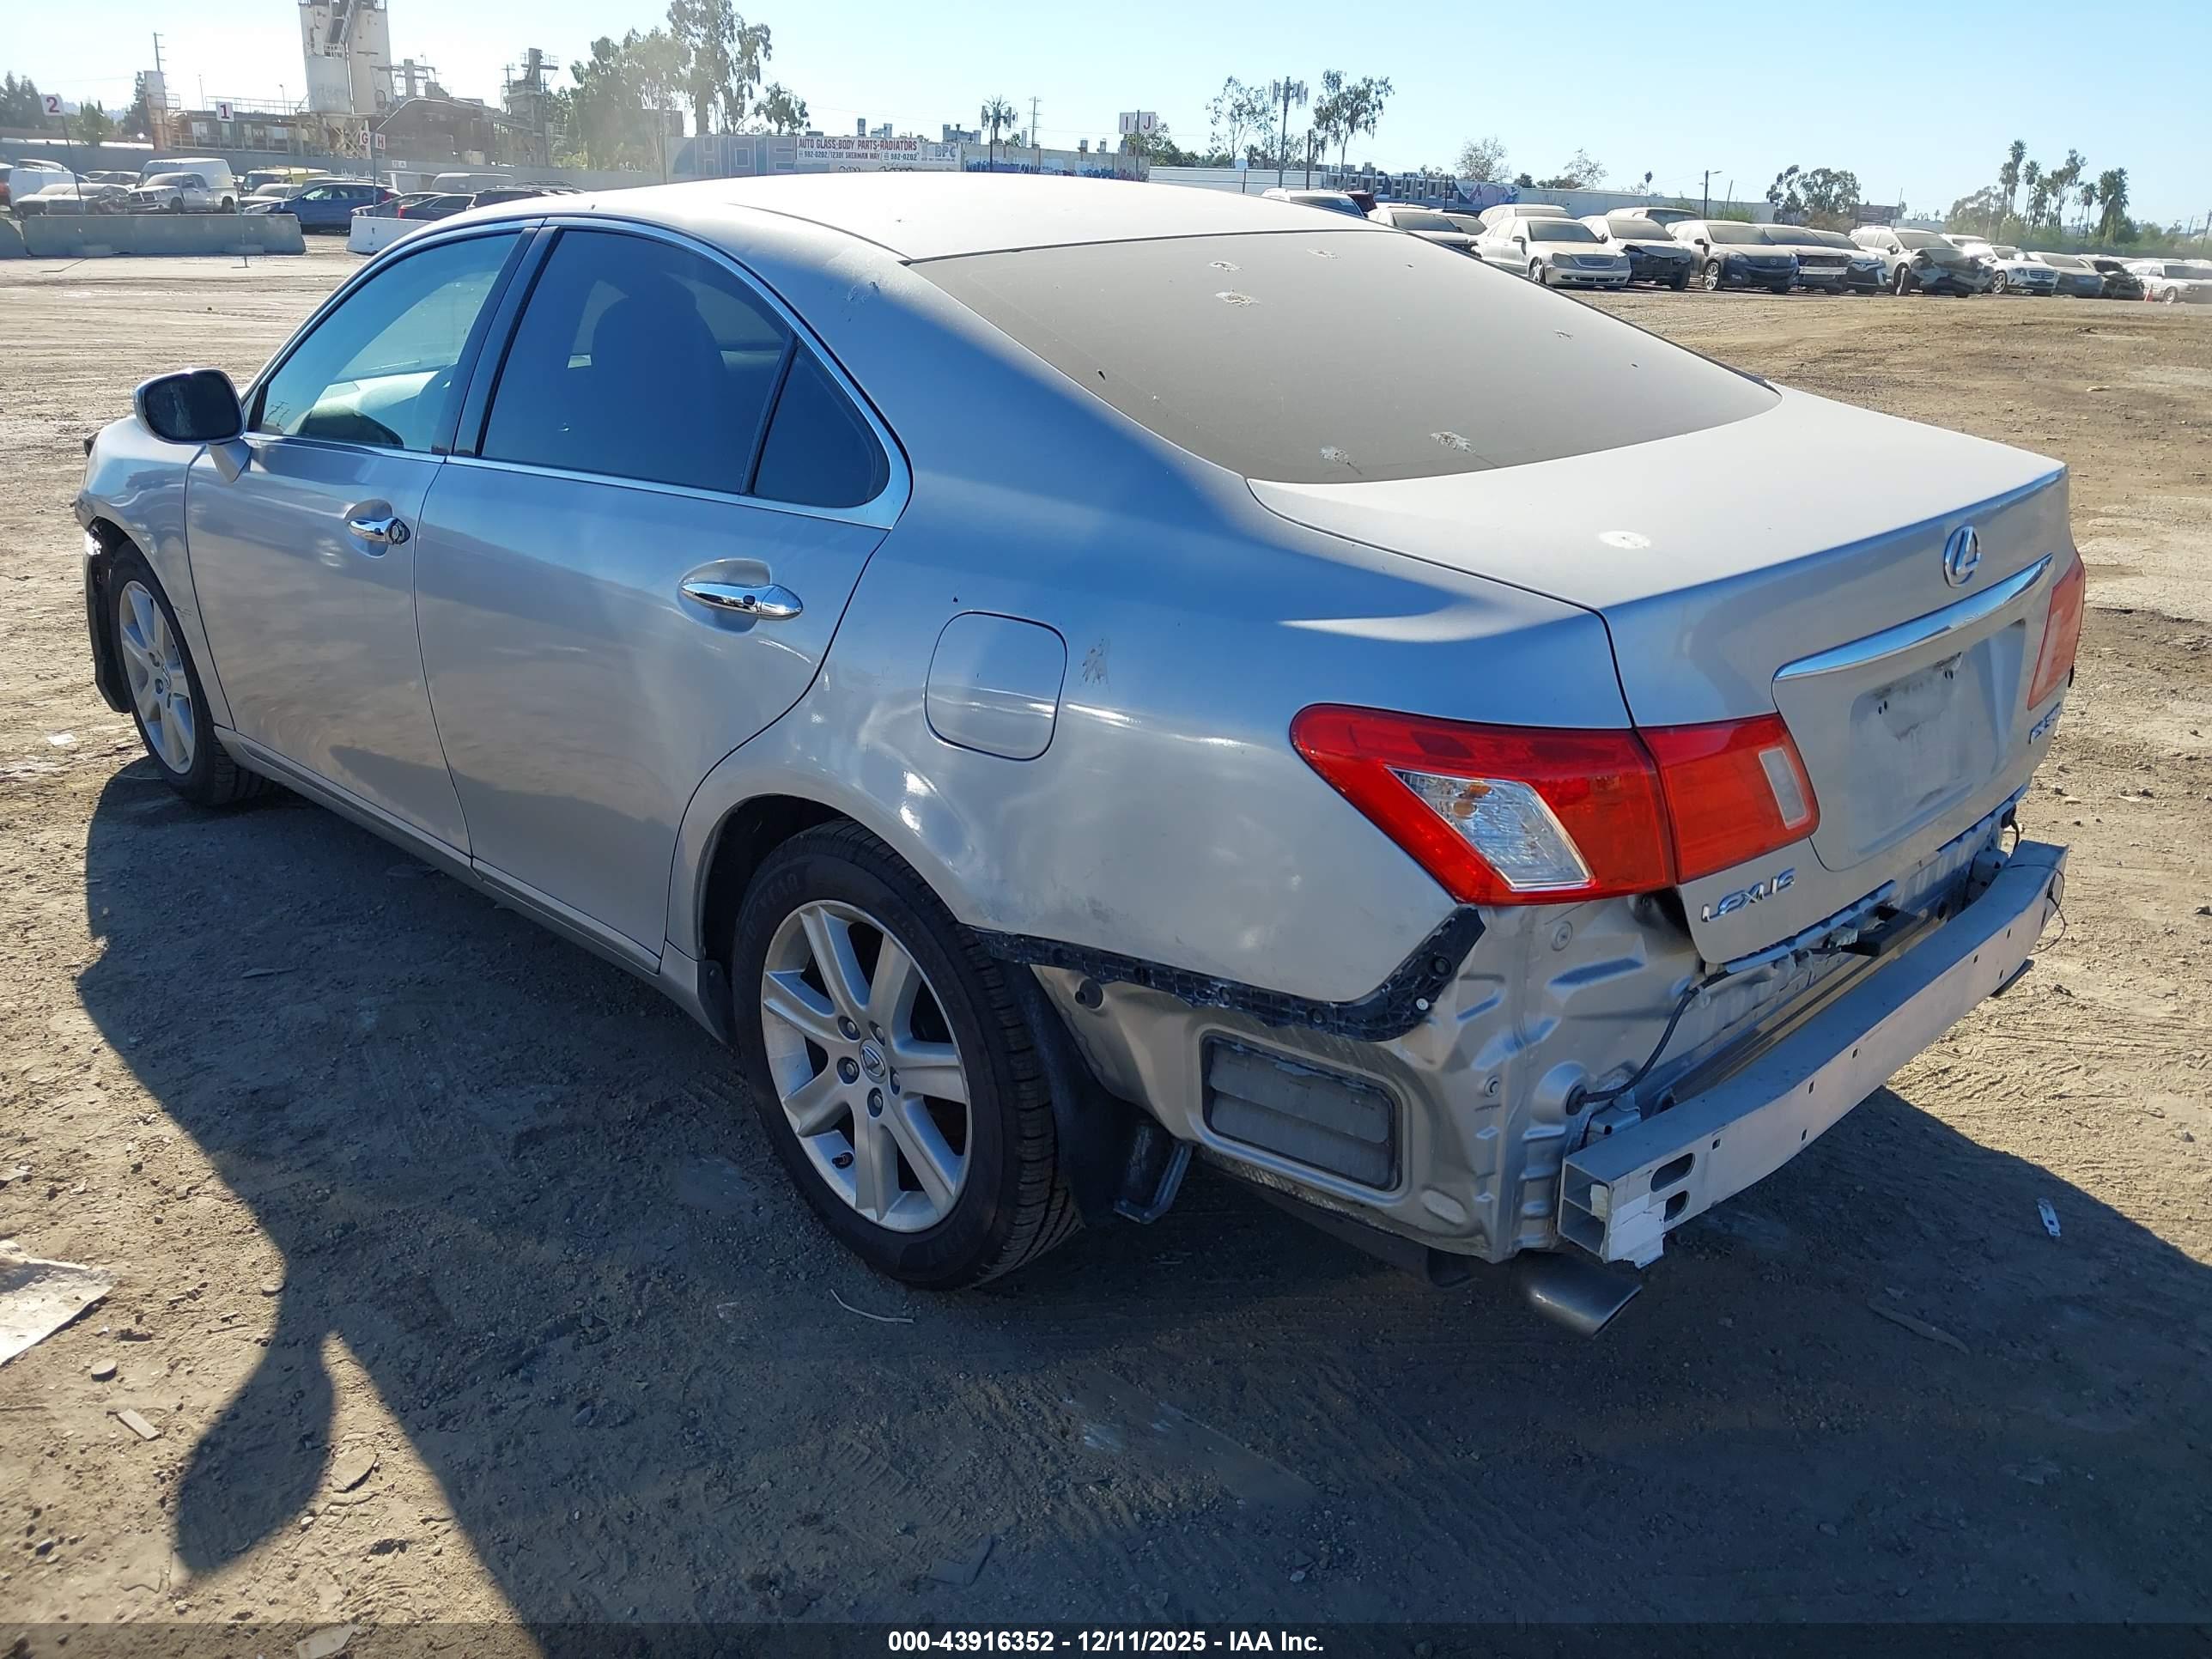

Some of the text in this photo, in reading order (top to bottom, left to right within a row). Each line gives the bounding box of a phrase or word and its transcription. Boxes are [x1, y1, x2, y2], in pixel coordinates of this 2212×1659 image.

[46, 96, 60, 112] 2
[220, 104, 230, 119] 1
[1143, 115, 1152, 131] J
[361, 131, 369, 145] G
[799, 138, 814, 149] AUTO
[1700, 867, 1796, 922] LEXUS
